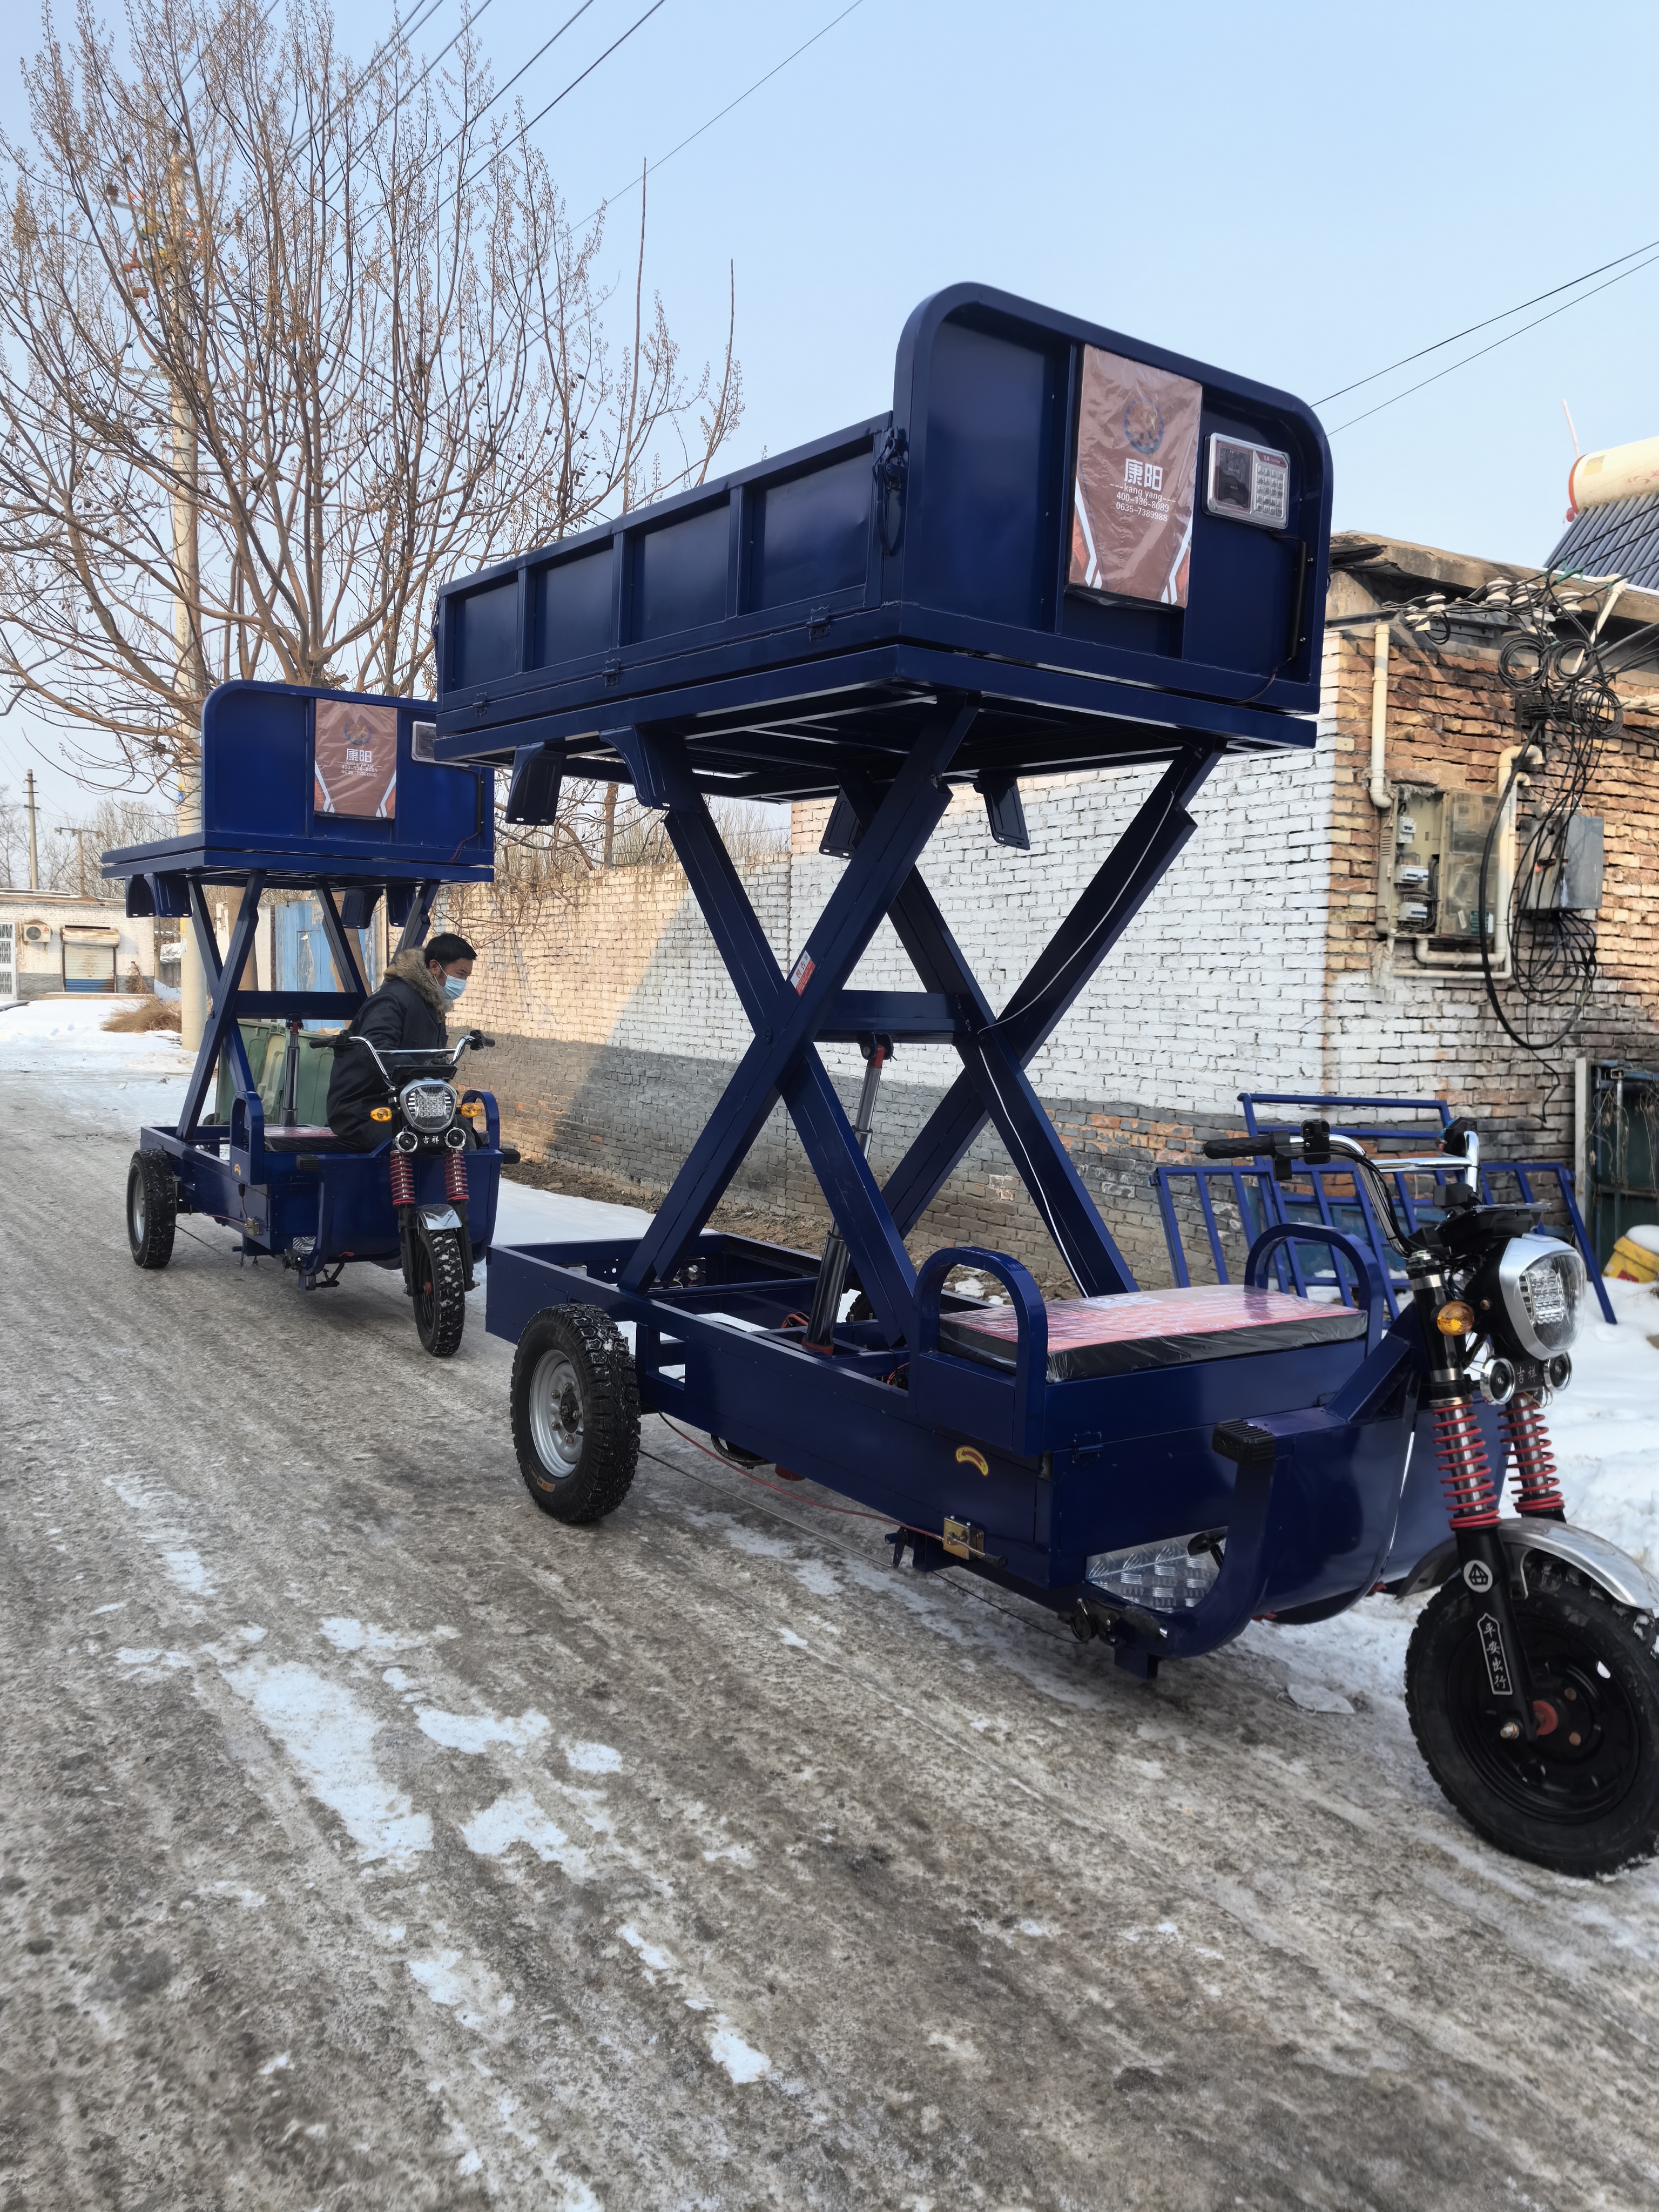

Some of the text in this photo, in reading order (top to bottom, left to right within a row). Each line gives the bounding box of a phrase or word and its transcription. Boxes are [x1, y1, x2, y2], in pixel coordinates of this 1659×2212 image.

[1124, 458, 1163, 491] 康阳
[1116, 491, 1169, 512] 400-136-8089
[1116, 502, 1168, 522] 0635-7389988
[346, 748, 372, 763] 康阳
[422, 1136, 439, 1144] 吉祥
[1517, 1364, 1537, 1384] 吉祥
[1483, 1622, 1506, 1689] 平安出行
